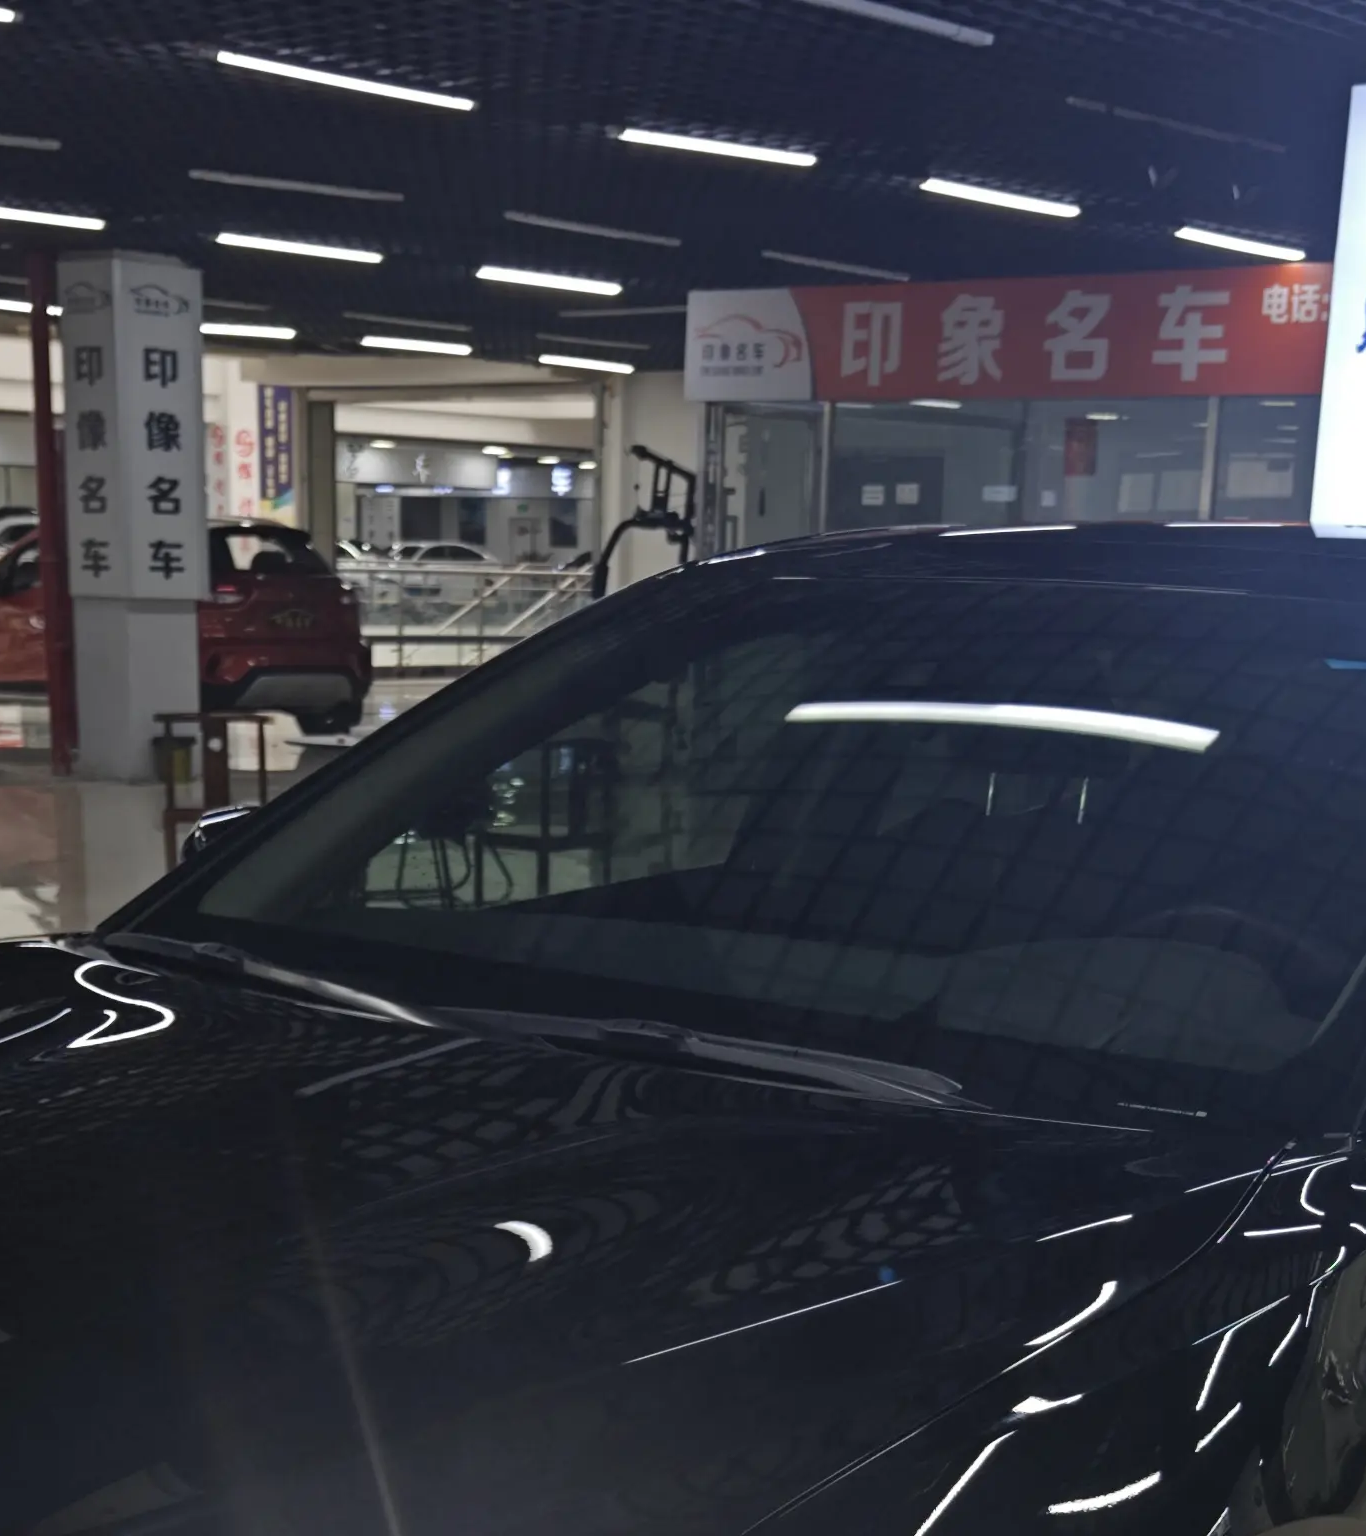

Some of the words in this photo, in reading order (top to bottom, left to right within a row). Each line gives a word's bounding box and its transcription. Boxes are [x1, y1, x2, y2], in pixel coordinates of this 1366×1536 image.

[841, 284, 1231, 388] 印象名车
[72, 346, 112, 580] 印像名车
[142, 347, 185, 580] 印像名车
